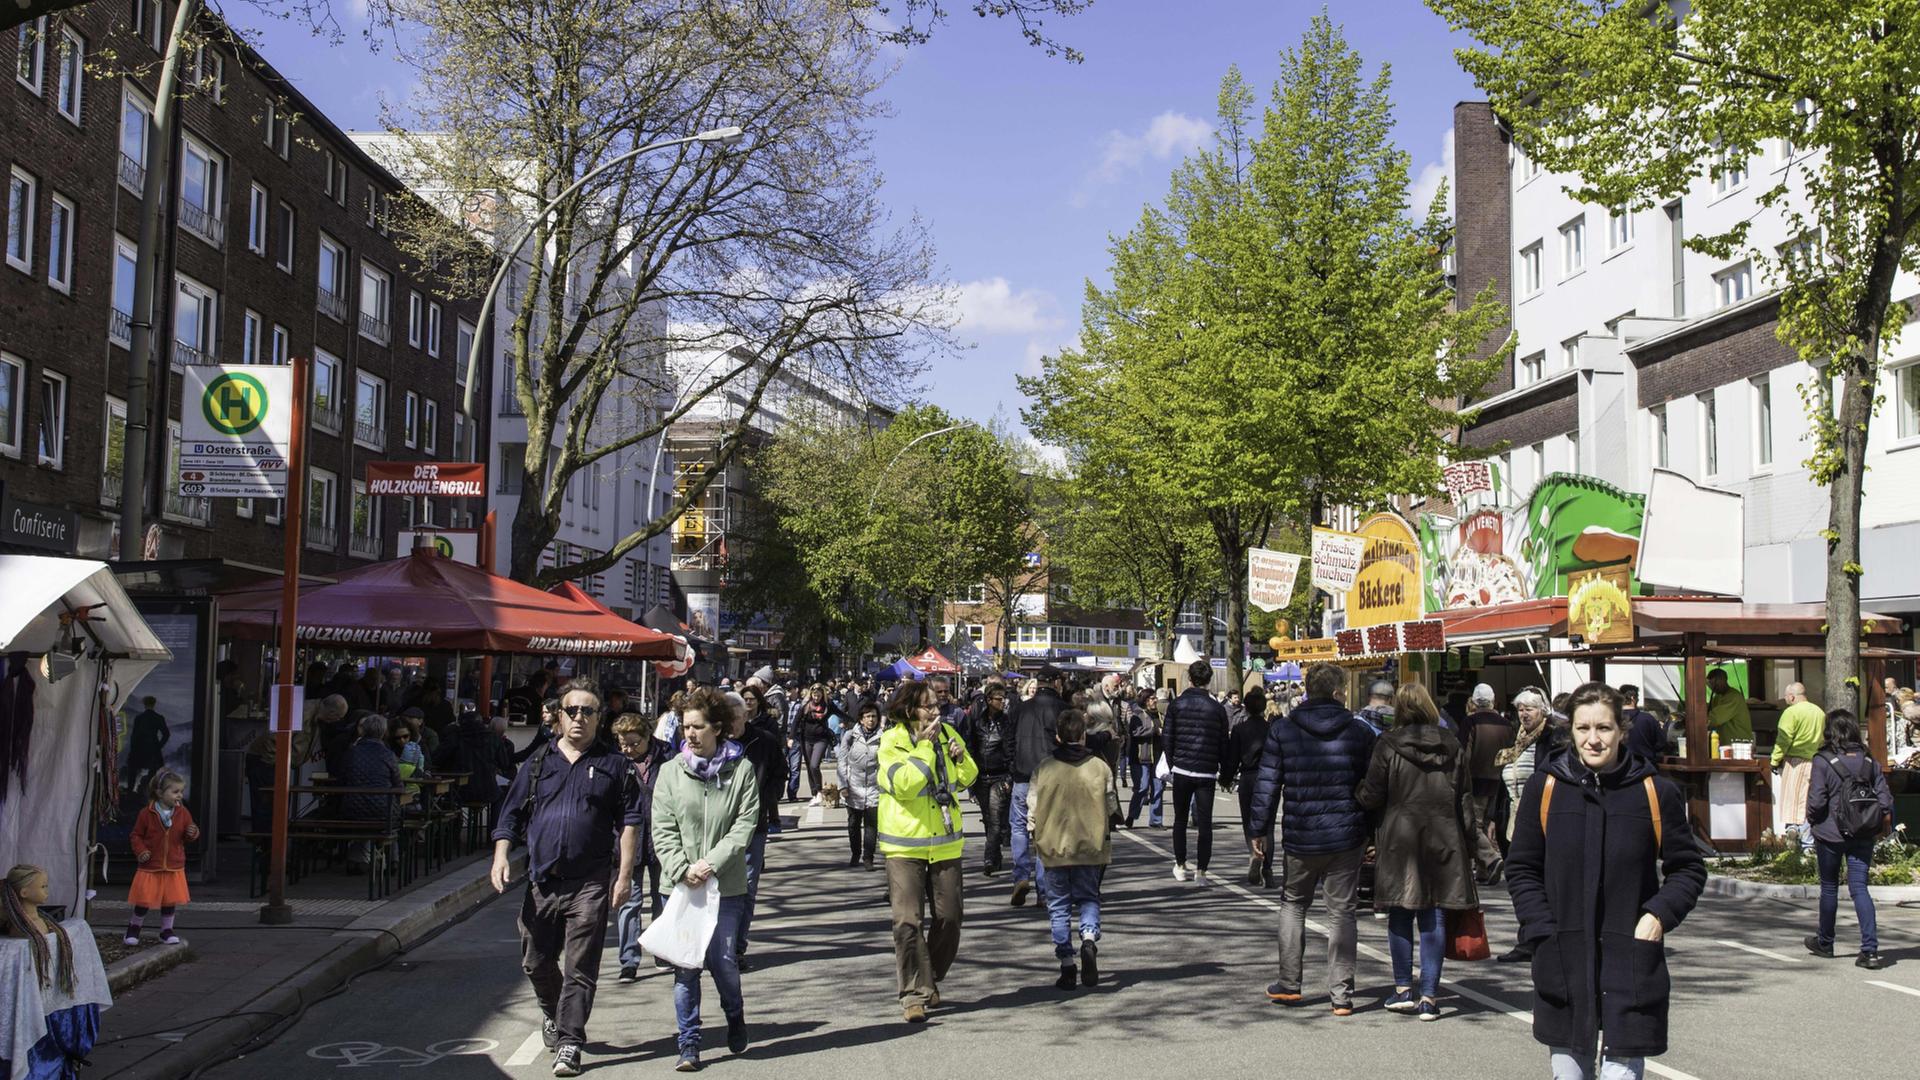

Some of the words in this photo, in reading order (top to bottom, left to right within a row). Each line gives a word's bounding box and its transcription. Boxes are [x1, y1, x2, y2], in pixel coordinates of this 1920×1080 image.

[206, 445, 271, 455] Osterstraße
[259, 460, 283, 469] HVV
[413, 465, 439, 480] DER
[190, 472, 197, 480] 4
[185, 485, 203, 493] 603
[370, 479, 481, 496] HOLZKOHLENGRILL
[13, 508, 66, 540] Confiserie
[1320, 540, 1356, 556] Frische
[1316, 565, 1352, 584] kuchen
[1359, 574, 1405, 610] Bäckerei
[296, 625, 432, 646] HOLZKOHLENGRILL
[527, 636, 633, 653] HOLZKOHLENGRILL
